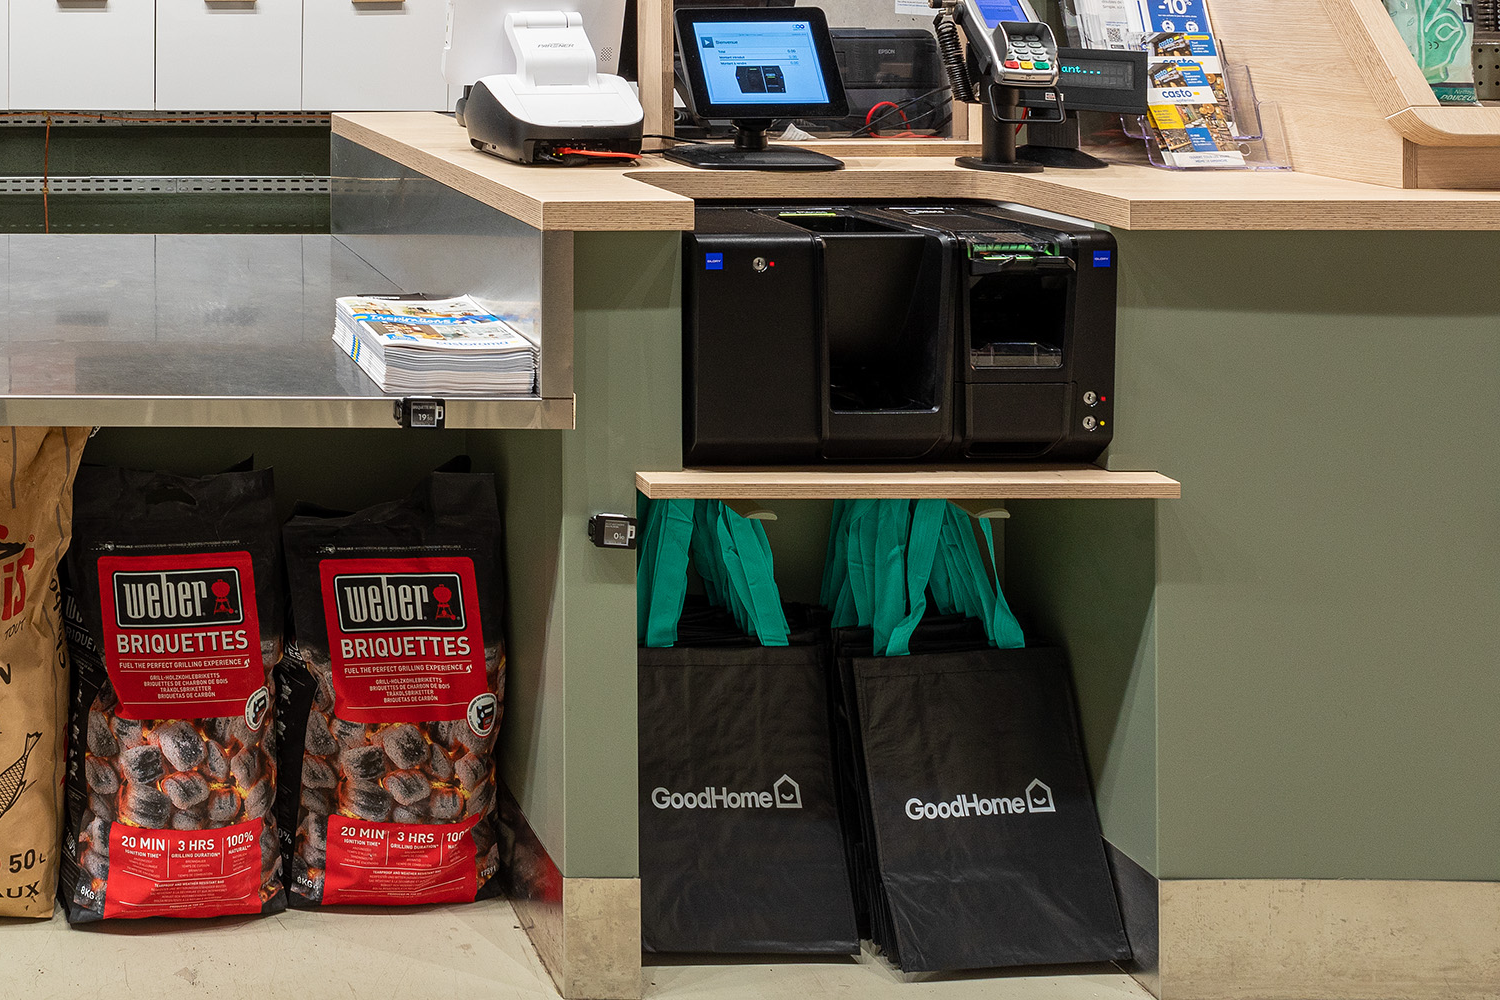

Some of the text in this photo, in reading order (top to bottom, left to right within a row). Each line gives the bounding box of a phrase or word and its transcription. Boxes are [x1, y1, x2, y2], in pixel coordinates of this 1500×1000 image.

[1162, 90, 1192, 98] casto
[123, 573, 208, 619] weber
[344, 576, 429, 622] weber
[116, 630, 249, 654] BRIQUETTES
[341, 636, 471, 659] BRIQUETTES
[204, 659, 241, 667] EXPERIENCE
[651, 786, 773, 811] GoodHome
[904, 795, 1026, 821] GoodHome
[226, 830, 254, 848] 100%
[341, 826, 385, 840] 20 MIN
[397, 832, 434, 843] 3 HRS
[121, 835, 165, 851] 20 MIN
[178, 839, 215, 851] 3 HRS
